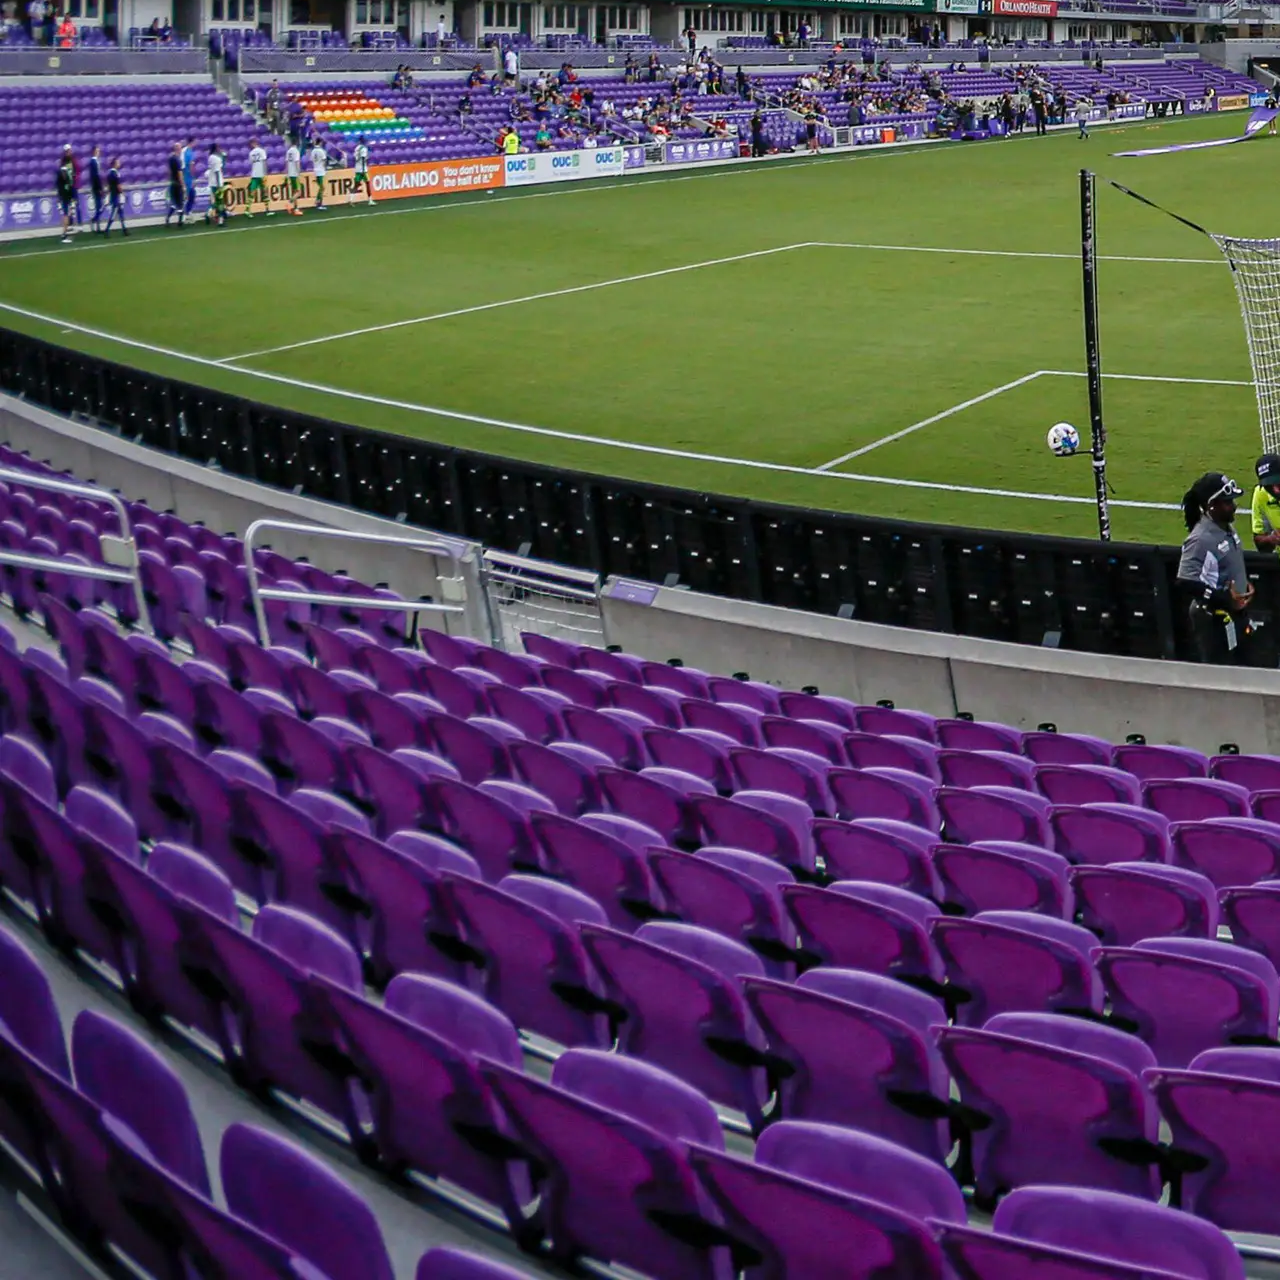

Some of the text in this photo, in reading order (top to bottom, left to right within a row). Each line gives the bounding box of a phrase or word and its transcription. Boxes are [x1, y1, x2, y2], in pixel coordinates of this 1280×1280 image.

[1000, 0, 1029, 12] ORLANDO
[552, 154, 572, 167] OUC
[596, 151, 614, 164] OUC
[507, 159, 527, 172] OUC
[372, 170, 439, 191] ORLANDO
